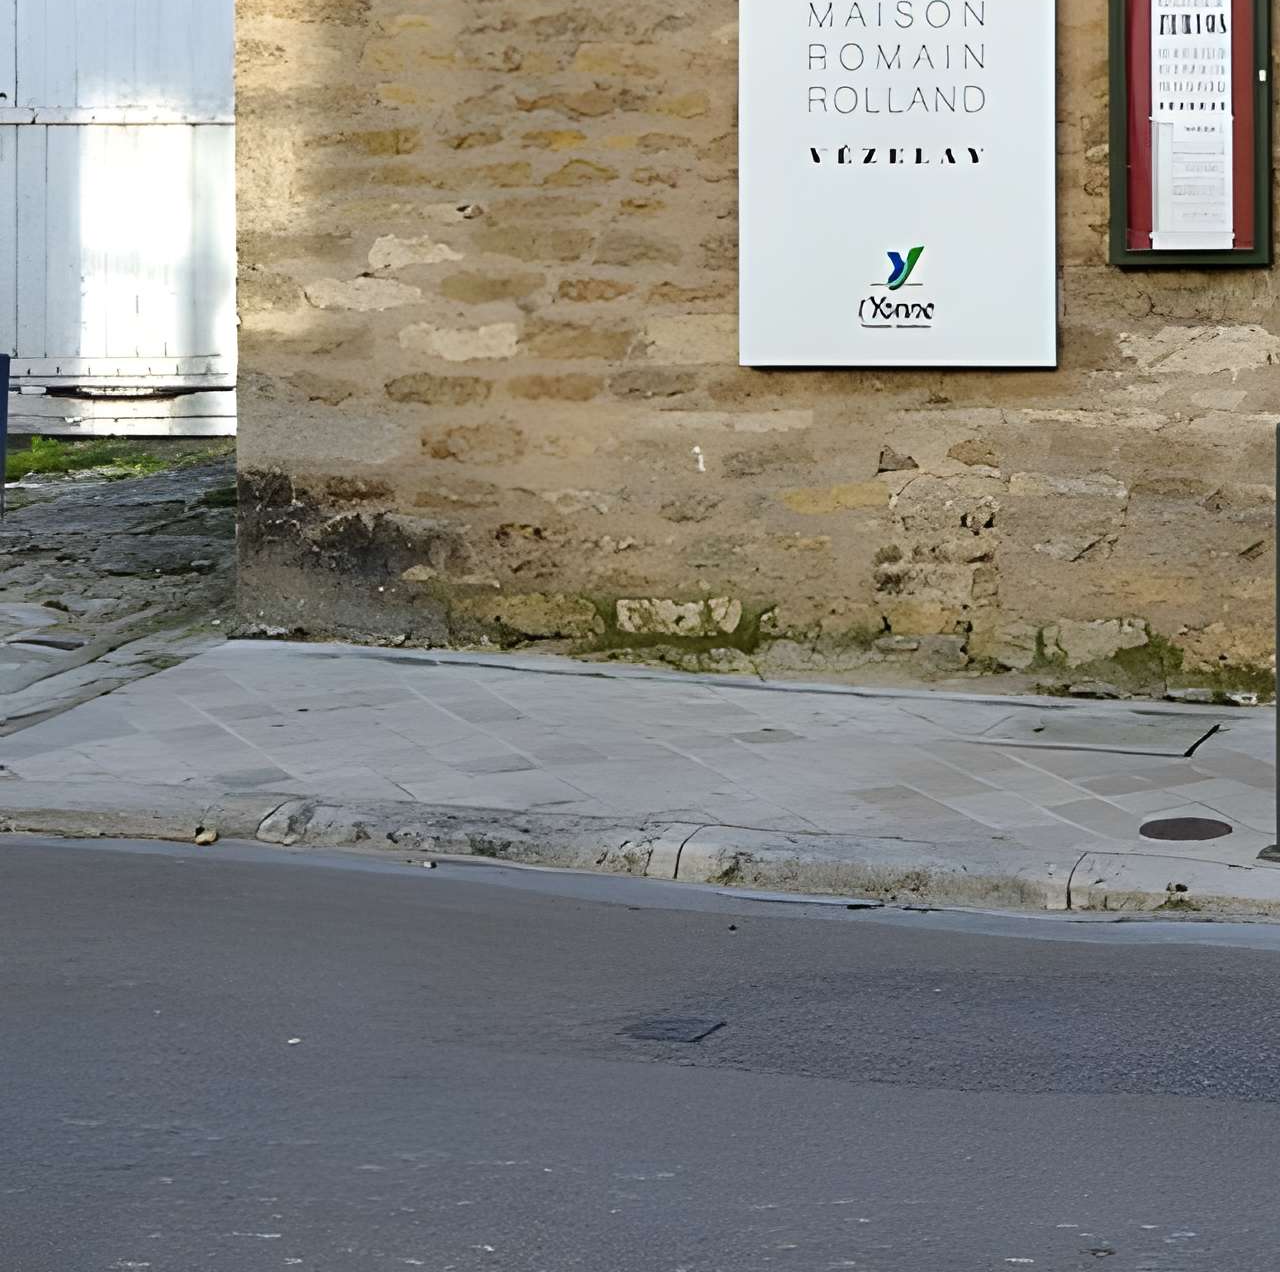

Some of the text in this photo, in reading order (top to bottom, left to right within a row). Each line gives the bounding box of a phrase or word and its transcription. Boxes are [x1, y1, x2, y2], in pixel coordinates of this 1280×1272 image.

[808, 0, 985, 28] MAISON
[808, 43, 985, 71] ROMAIN
[808, 86, 986, 115] ROLLAND
